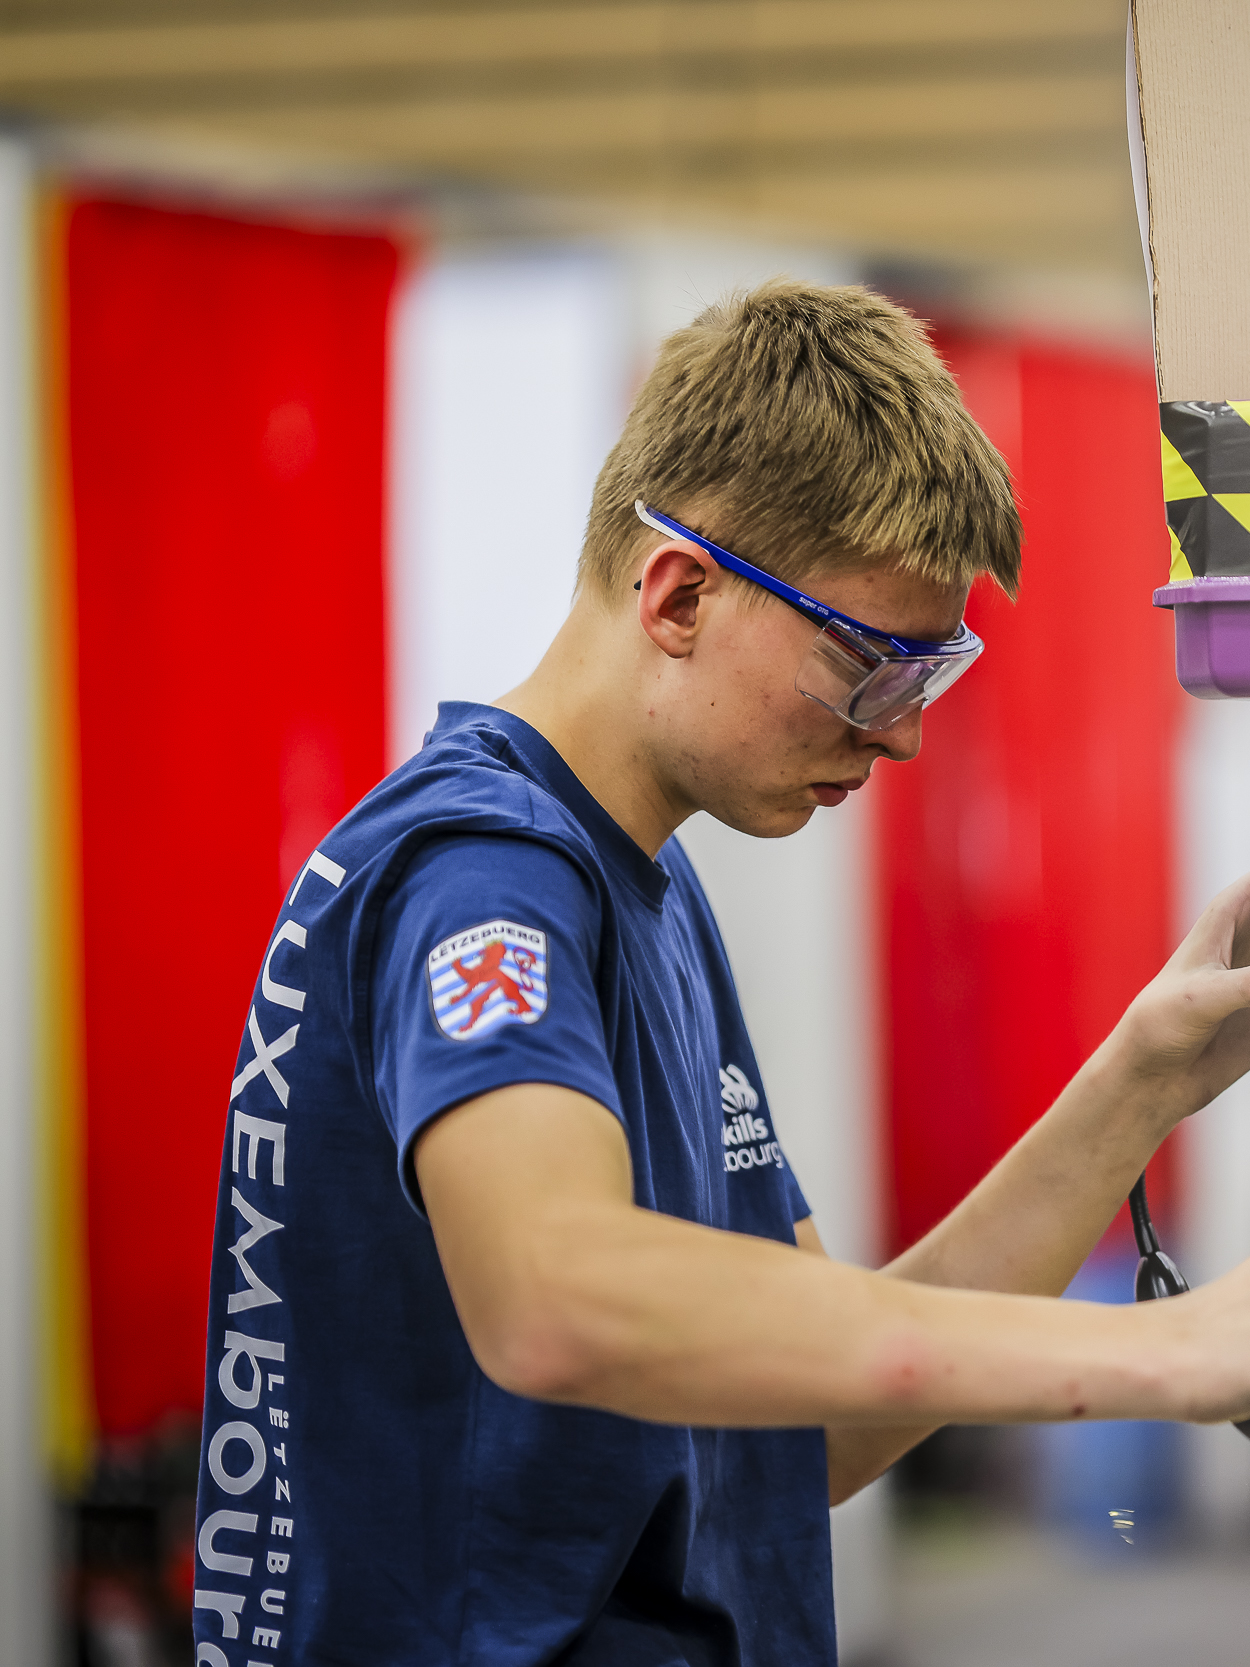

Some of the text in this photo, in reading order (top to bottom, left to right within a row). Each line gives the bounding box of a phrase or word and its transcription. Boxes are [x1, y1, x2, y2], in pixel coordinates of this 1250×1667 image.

[430, 926, 540, 963] LËTZEBUERG
[721, 1112, 769, 1146] kills
[723, 1141, 785, 1172] bourg
